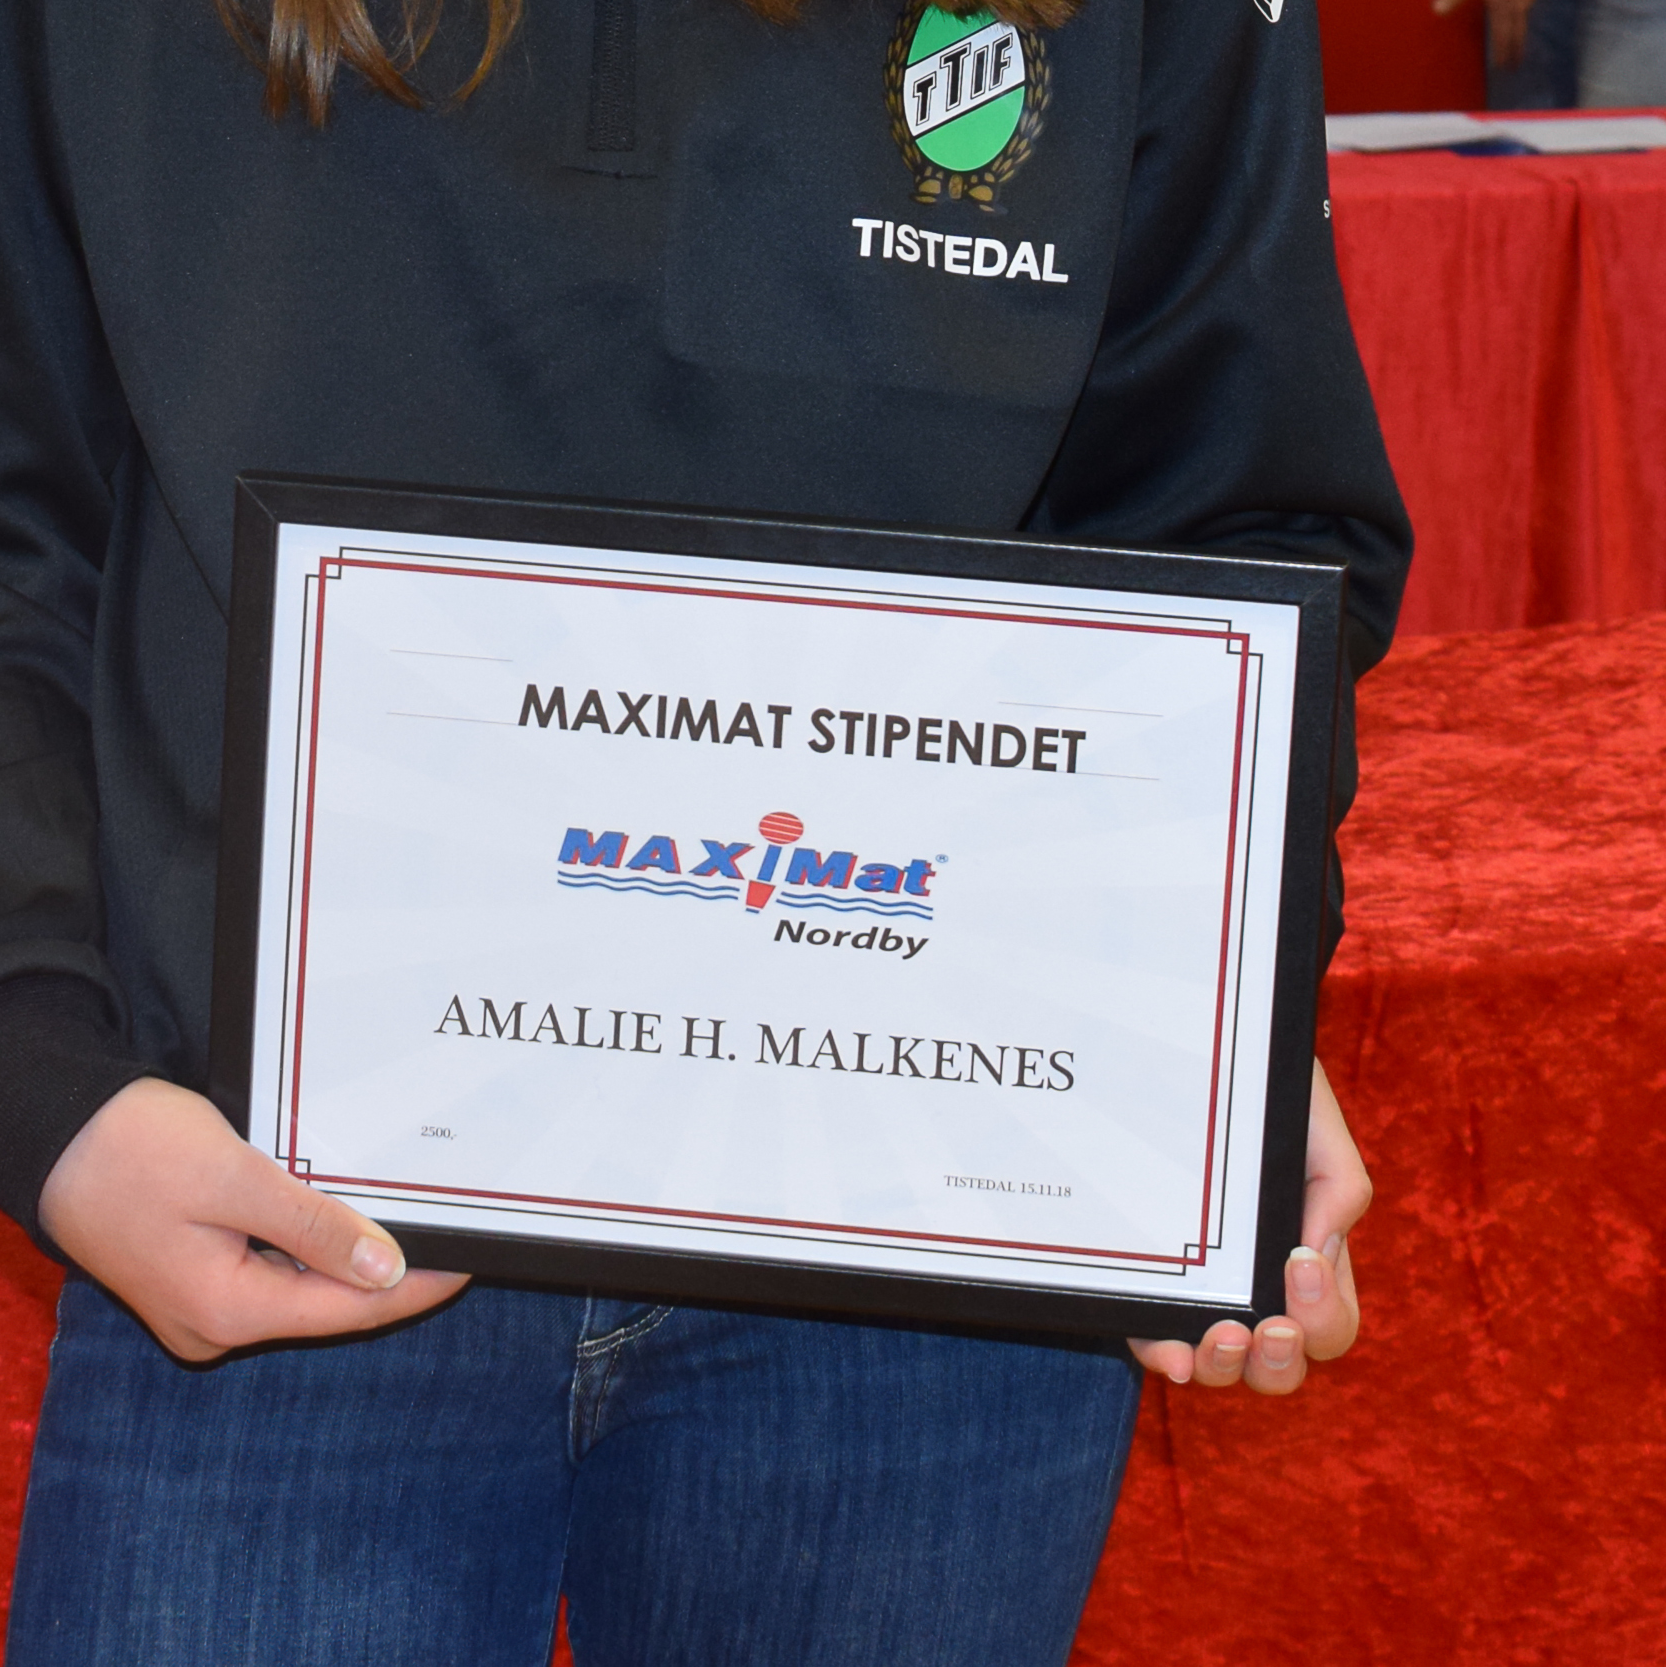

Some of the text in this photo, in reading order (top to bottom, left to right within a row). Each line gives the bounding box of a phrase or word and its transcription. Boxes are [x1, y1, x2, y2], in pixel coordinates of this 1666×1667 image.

[912, 32, 1014, 127] TTIF
[851, 217, 1070, 284] TISTEDAL
[517, 683, 1088, 775] MAXIMAT STIPENDET
[773, 919, 930, 961] Nordby
[434, 994, 1077, 1093] AMALIE H. MALKENES
[944, 1175, 1072, 1197] TISTEDAL 15.11.18
